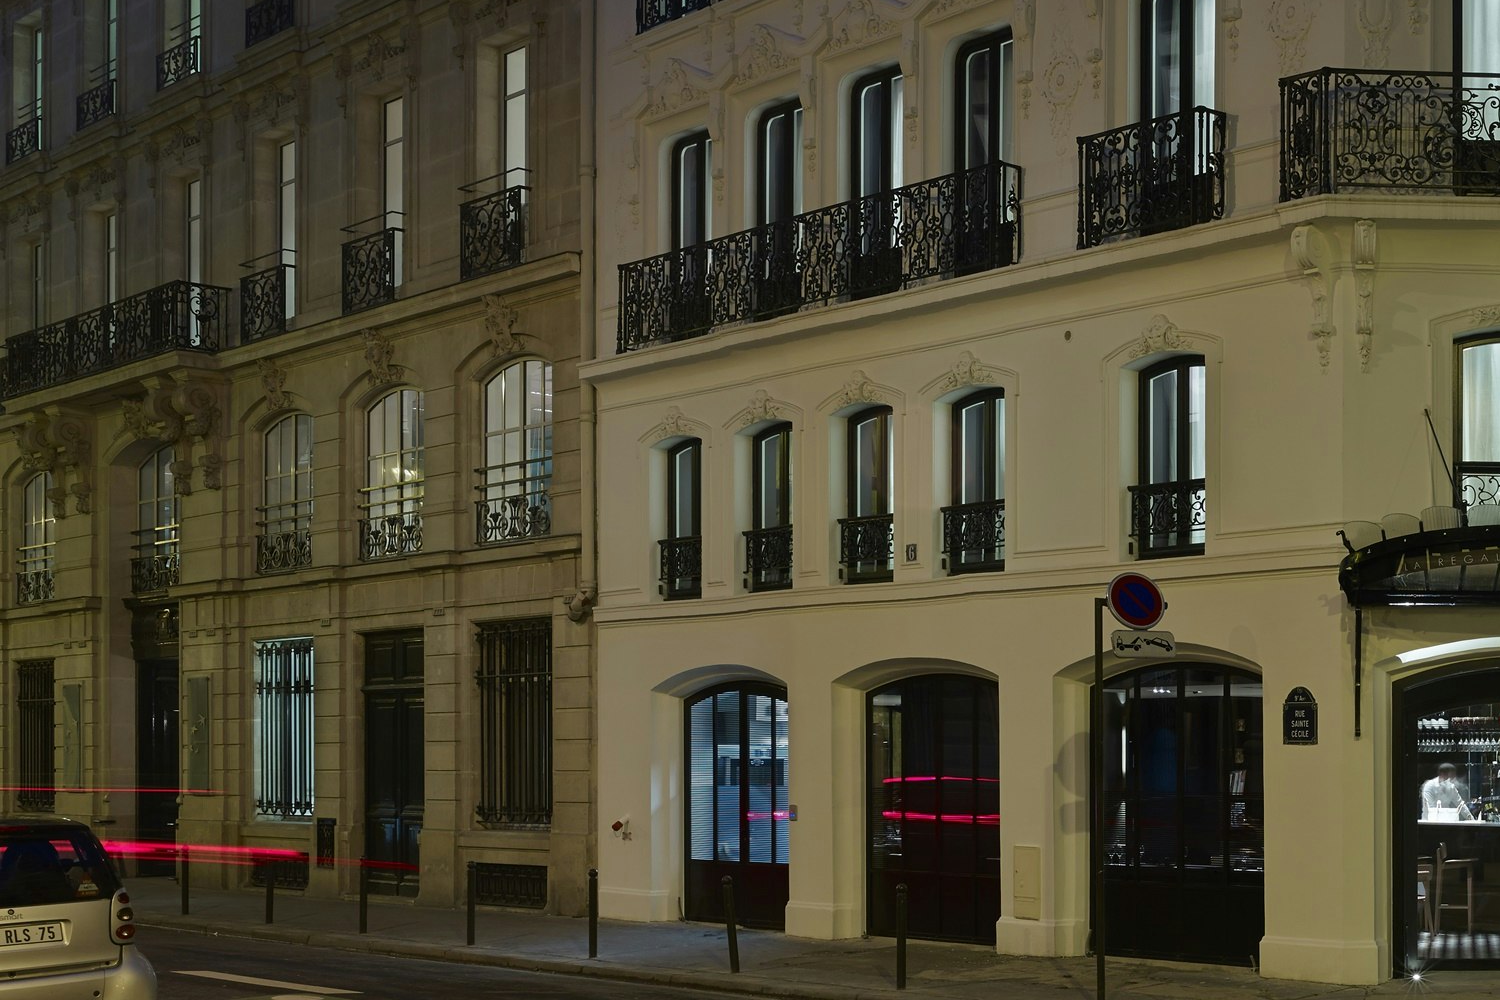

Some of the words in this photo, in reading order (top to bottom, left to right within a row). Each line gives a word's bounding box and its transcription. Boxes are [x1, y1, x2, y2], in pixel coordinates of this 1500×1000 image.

[909, 545, 915, 560] 6
[1404, 561, 1421, 571] LA
[1291, 729, 1309, 737] CÉCILE
[5, 929, 30, 943] RLS
[38, 926, 55, 940] 75
